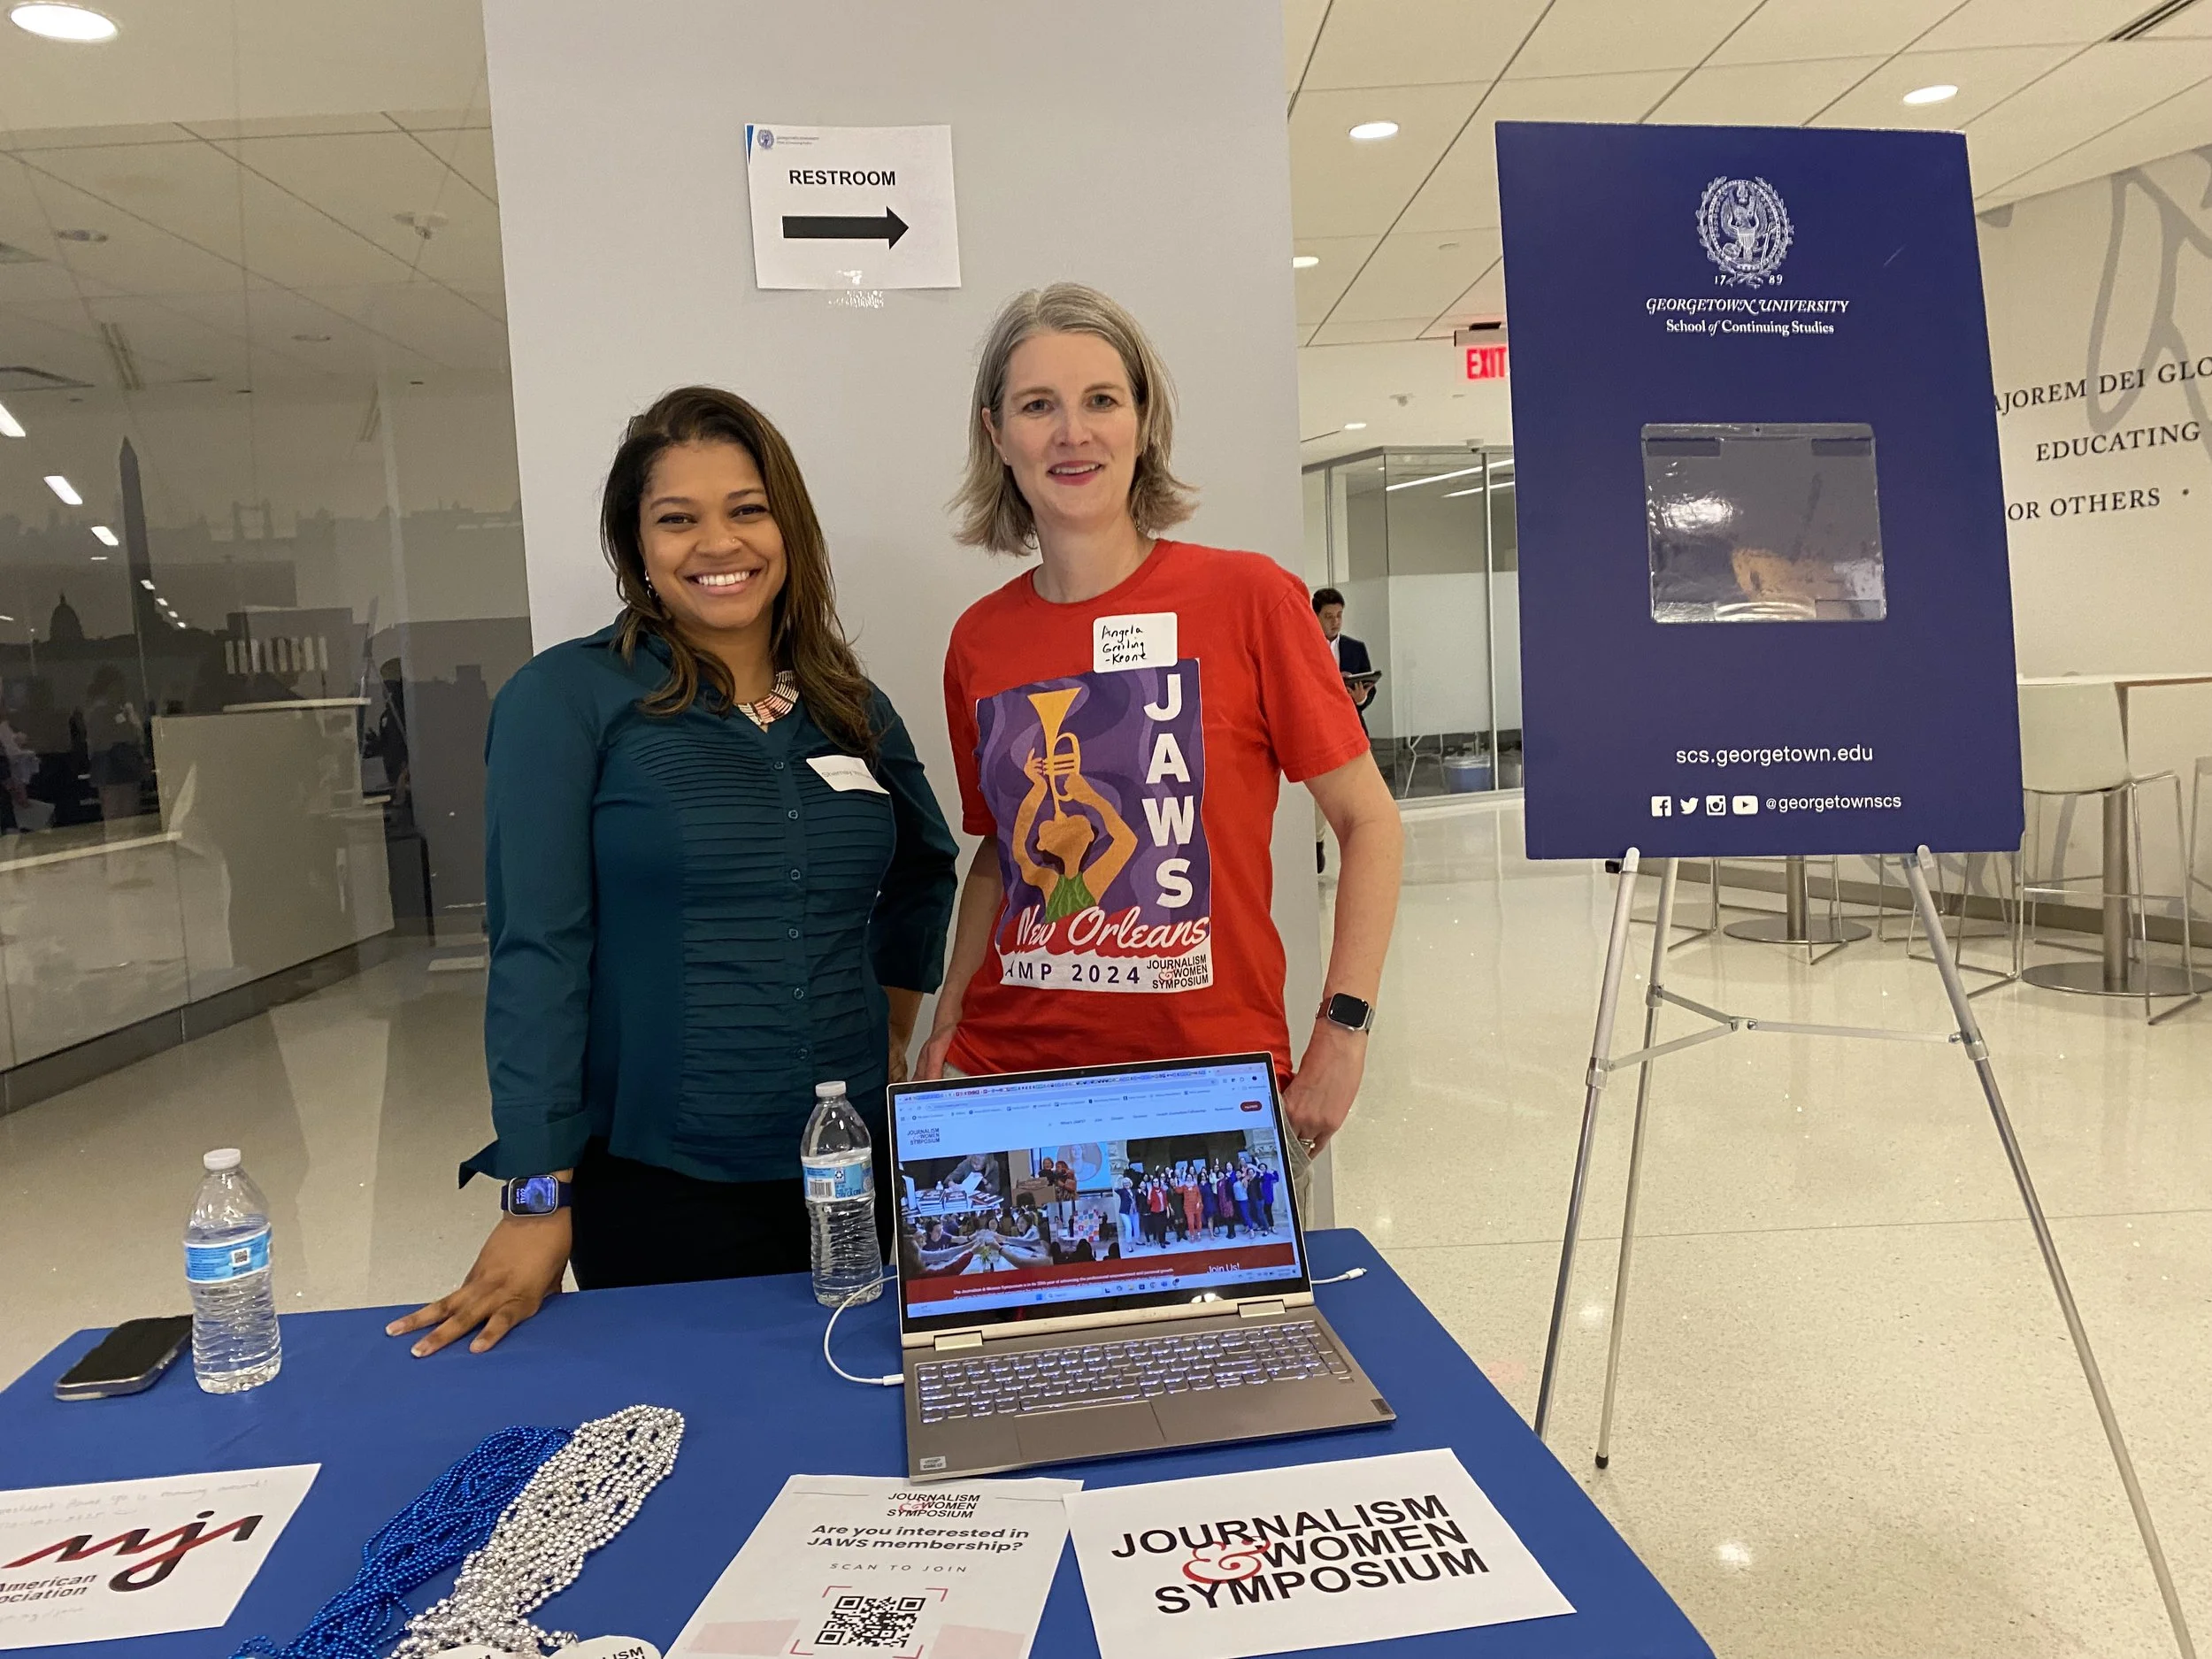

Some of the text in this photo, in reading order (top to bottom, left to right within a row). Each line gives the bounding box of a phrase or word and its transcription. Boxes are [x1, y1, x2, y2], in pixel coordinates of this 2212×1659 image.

[788, 170, 896, 186] RESTROOM
[1646, 298, 1850, 315] GEORGETOWN UNIVERSITY
[1666, 319, 1834, 337] School of Continuing Studies
[1467, 346, 1507, 380] EXIT
[2099, 368, 2146, 395] DEI
[2157, 357, 2212, 383] GLO
[2035, 421, 2201, 462] EDUCATING
[2050, 488, 2161, 517] OTHERS
[1102, 625, 1144, 643] Angela
[1676, 744, 1874, 767] scs.georgetown.edu
[1765, 795, 1902, 813] @georgetownscs
[1017, 905, 1211, 950] New Orleans
[1147, 955, 1207, 970] JOURNALISM
[1071, 964, 1141, 984] 2024
[1152, 974, 1209, 989] SYMPOSIUM
[887, 1492, 980, 1503] JOURNALISM
[886, 1509, 974, 1519] SYMPOSIUM
[811, 1525, 1029, 1540] Are you interested in
[1111, 1494, 1450, 1558] JOURNALISM
[806, 1537, 1025, 1555] JAWS membership?
[829, 1563, 879, 1572] SCAN
[1156, 1548, 1490, 1615] SYMPOSIUM
